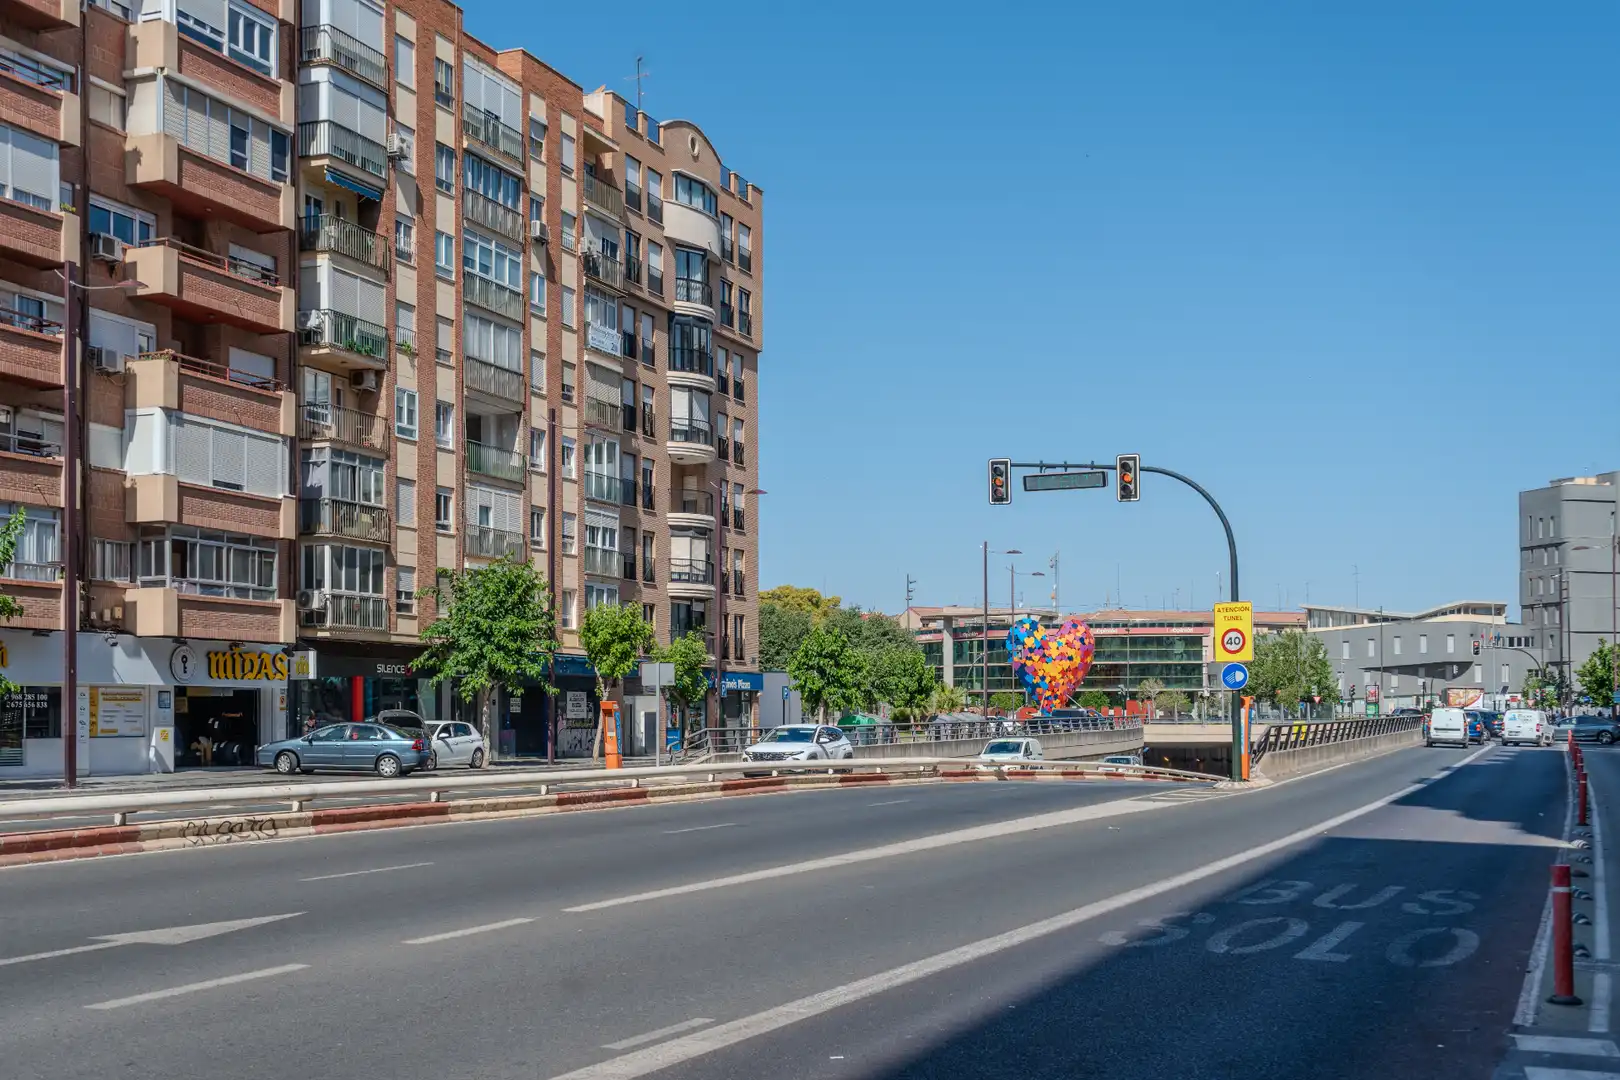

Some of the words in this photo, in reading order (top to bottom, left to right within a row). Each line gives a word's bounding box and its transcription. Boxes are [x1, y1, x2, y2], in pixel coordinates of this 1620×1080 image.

[1226, 636, 1241, 646] 40
[376, 663, 406, 674] SILENCE
[738, 678, 751, 690] Pizza
[1231, 879, 1482, 916] BUS
